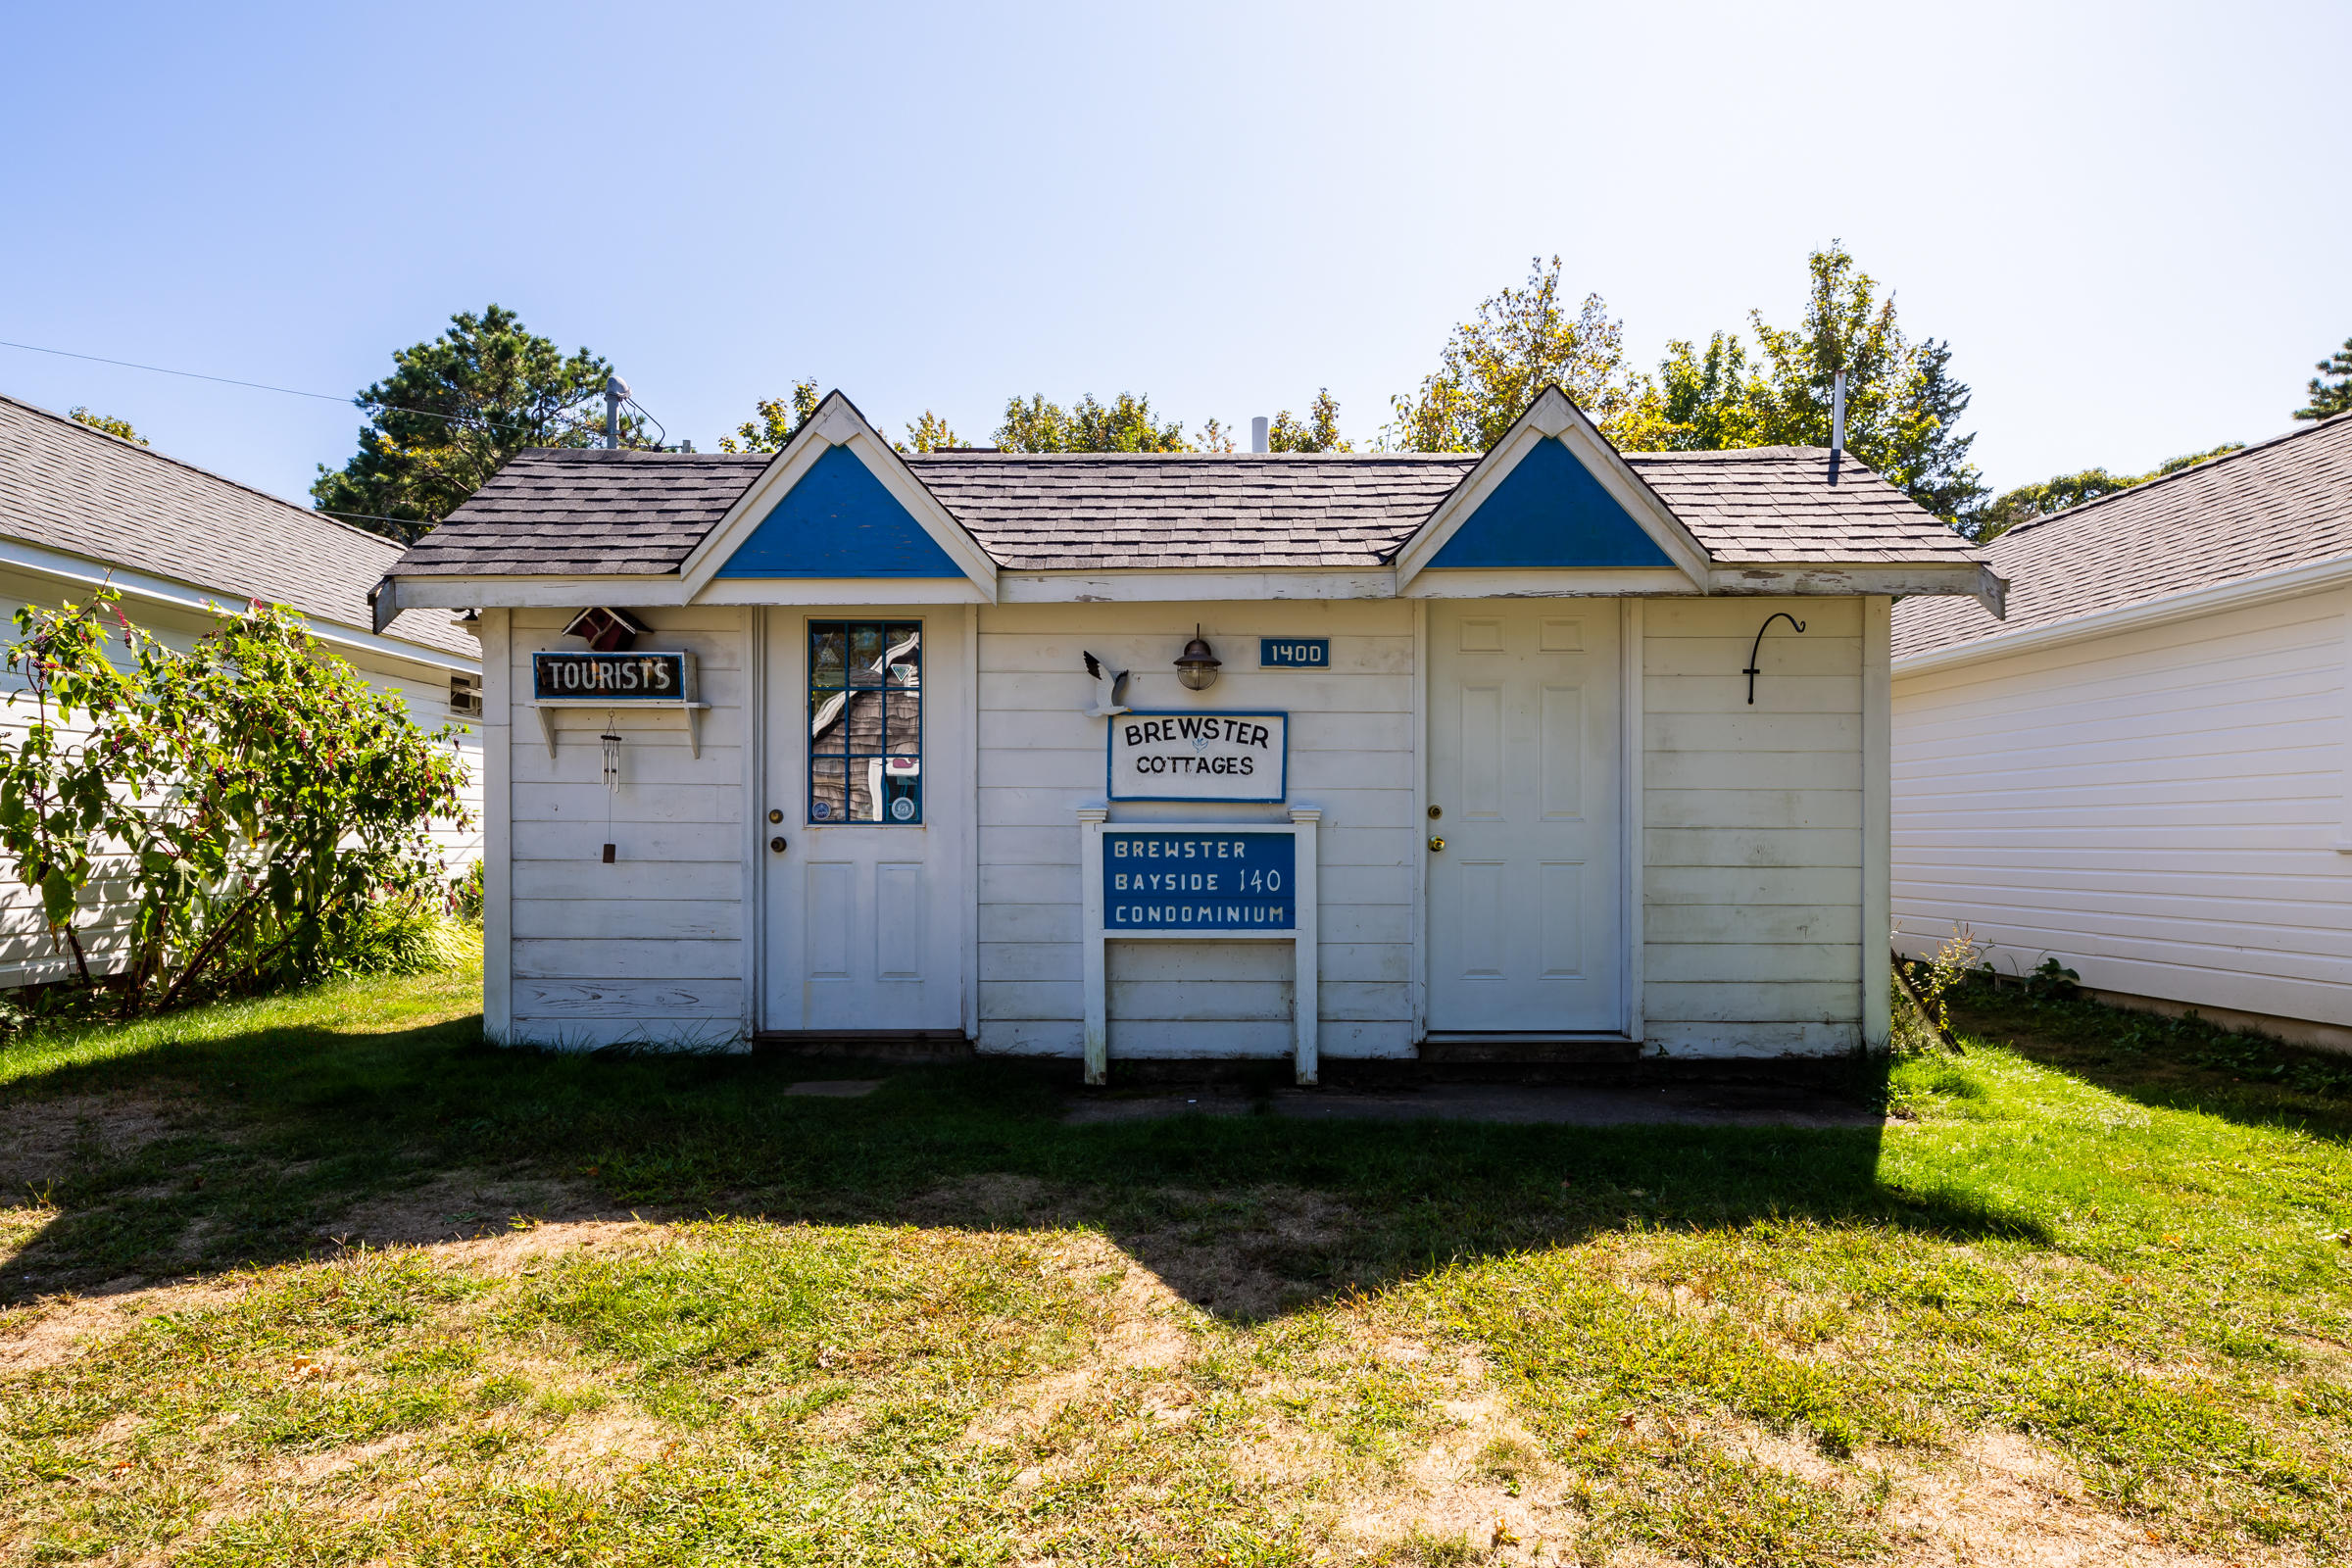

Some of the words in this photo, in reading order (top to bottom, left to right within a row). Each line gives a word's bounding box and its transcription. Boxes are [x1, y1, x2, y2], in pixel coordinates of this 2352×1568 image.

[548, 662, 671, 690] TOURISTS
[1125, 717, 1269, 749] BREWSTER
[1137, 756, 1253, 775] COTTAGES
[1114, 841, 1246, 858] BREWSTER
[1115, 873, 1218, 890] BAYSIDE
[1240, 868, 1281, 894] 140
[1115, 906, 1284, 922] CONDOMINIUM
